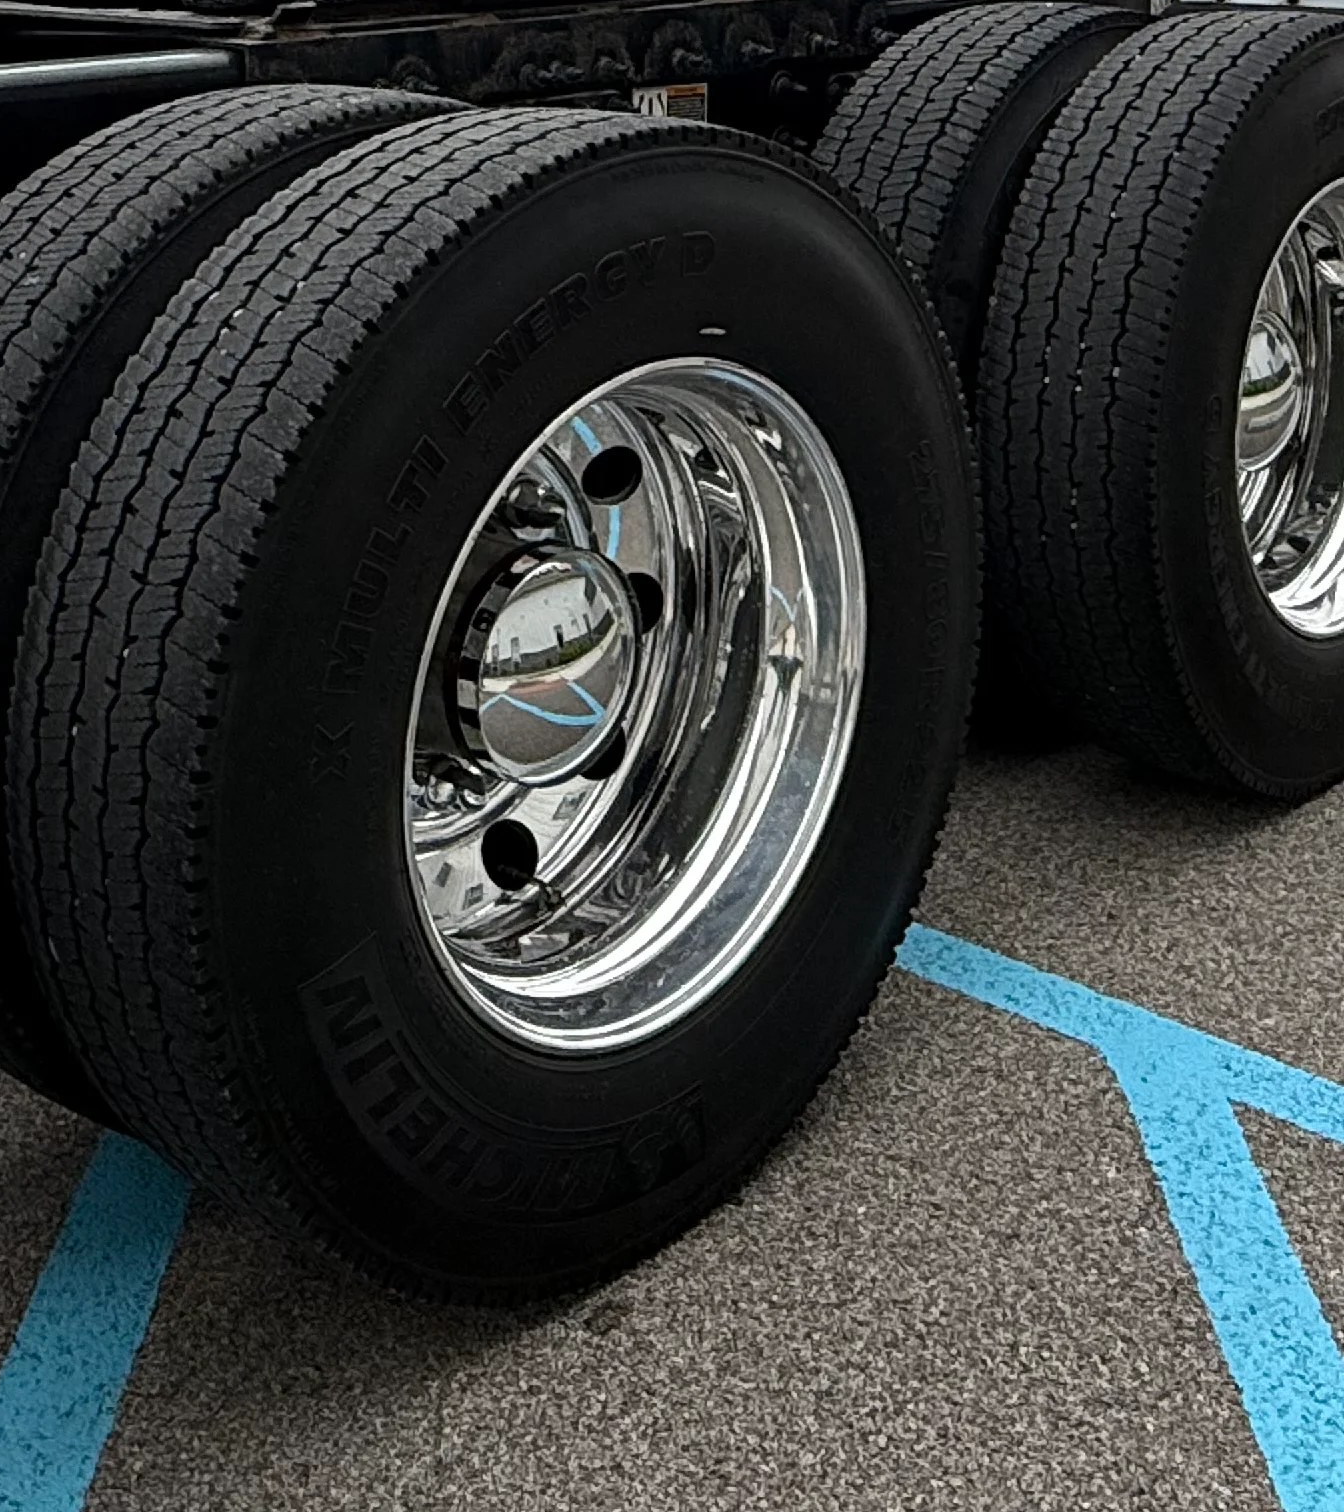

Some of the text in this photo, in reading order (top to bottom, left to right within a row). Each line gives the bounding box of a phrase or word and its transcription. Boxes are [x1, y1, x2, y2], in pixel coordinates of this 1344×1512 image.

[323, 433, 450, 694] MULTI
[442, 232, 668, 437] ENERGY
[679, 229, 718, 280] D
[317, 974, 617, 1212] MICHELIN
